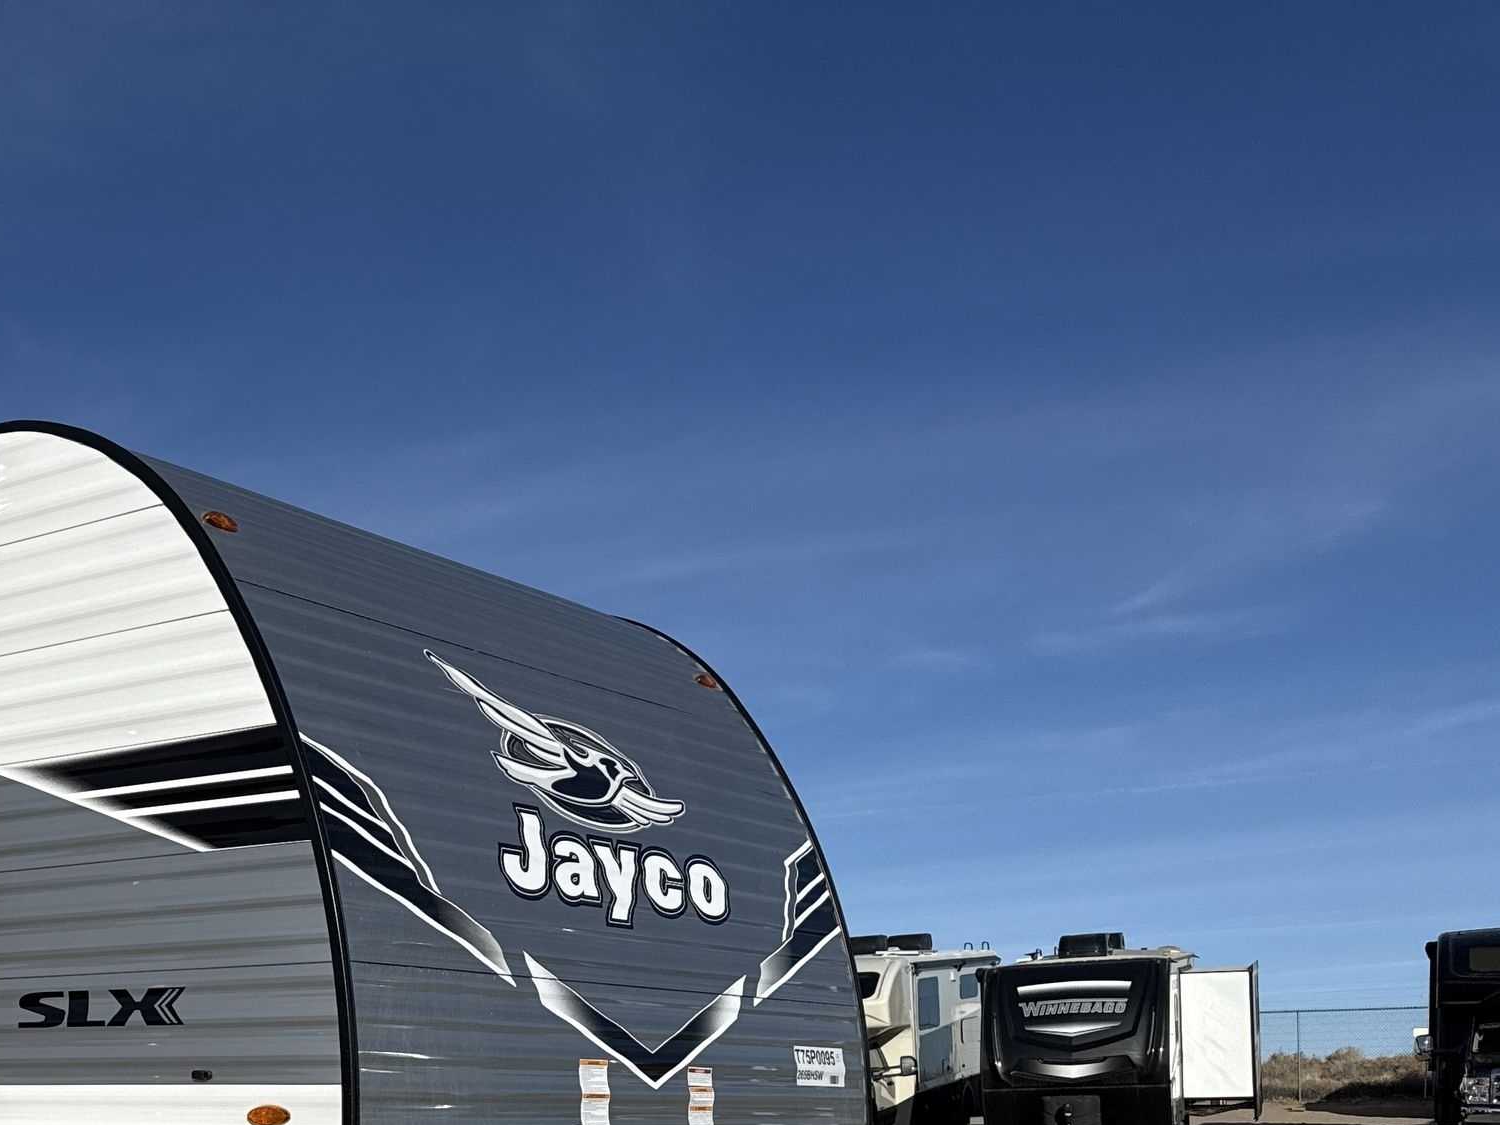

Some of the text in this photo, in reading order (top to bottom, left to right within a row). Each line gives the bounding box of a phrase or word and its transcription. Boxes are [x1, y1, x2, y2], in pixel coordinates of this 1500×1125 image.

[499, 803, 731, 929] Jayco
[18, 987, 186, 1028] SLX
[1019, 998, 1128, 1017] WINNEBAGO
[794, 1048, 836, 1066] T75P0095
